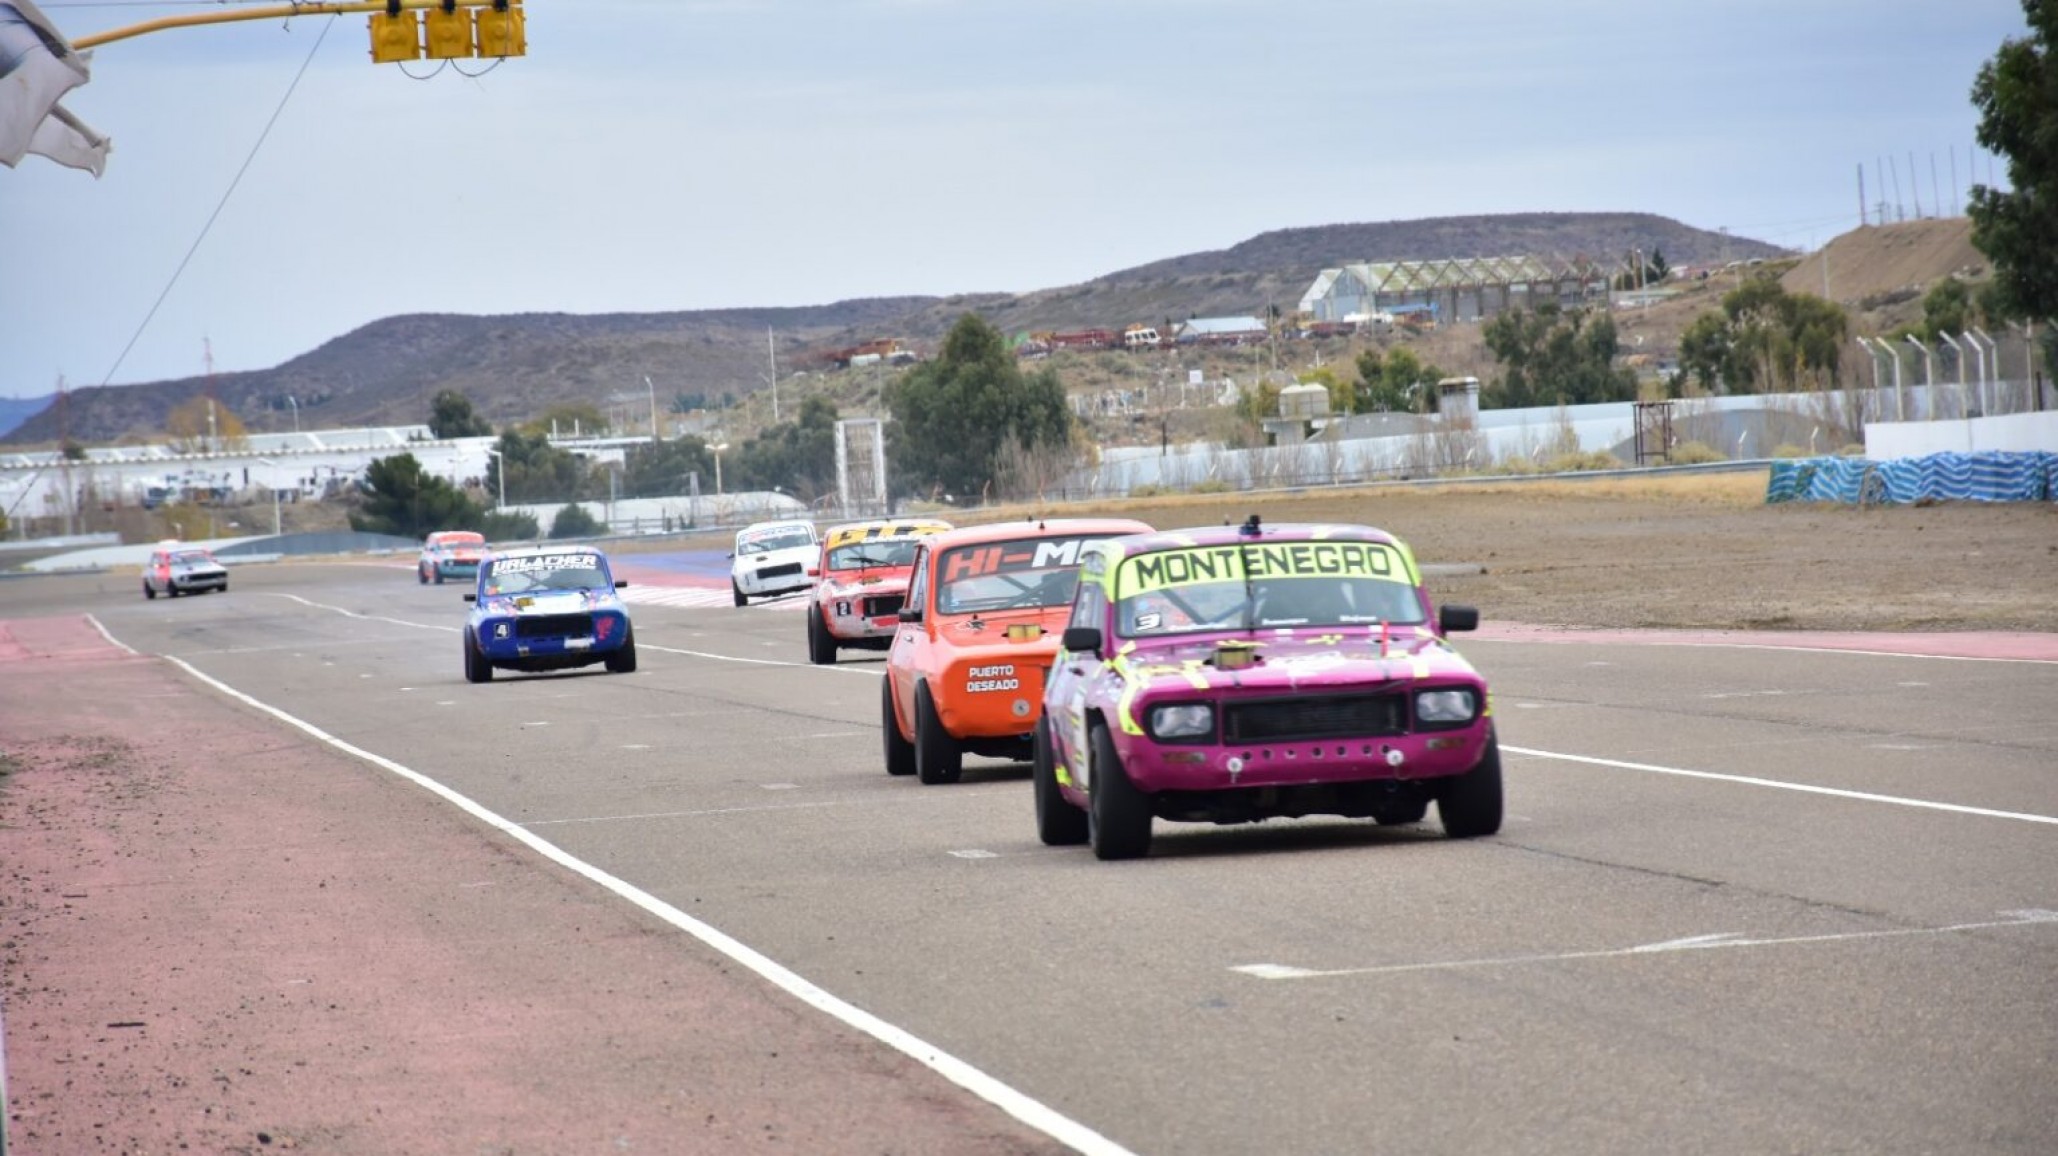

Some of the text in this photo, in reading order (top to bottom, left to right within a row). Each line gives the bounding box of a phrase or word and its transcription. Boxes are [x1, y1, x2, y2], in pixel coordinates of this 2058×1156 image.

[493, 554, 597, 573] URLACHER
[1135, 545, 1392, 589] MONTENEGRO
[1136, 612, 1160, 631] 3
[496, 624, 508, 638] 4
[969, 664, 1014, 678] PUERTO
[966, 679, 1019, 693] DESEADO
